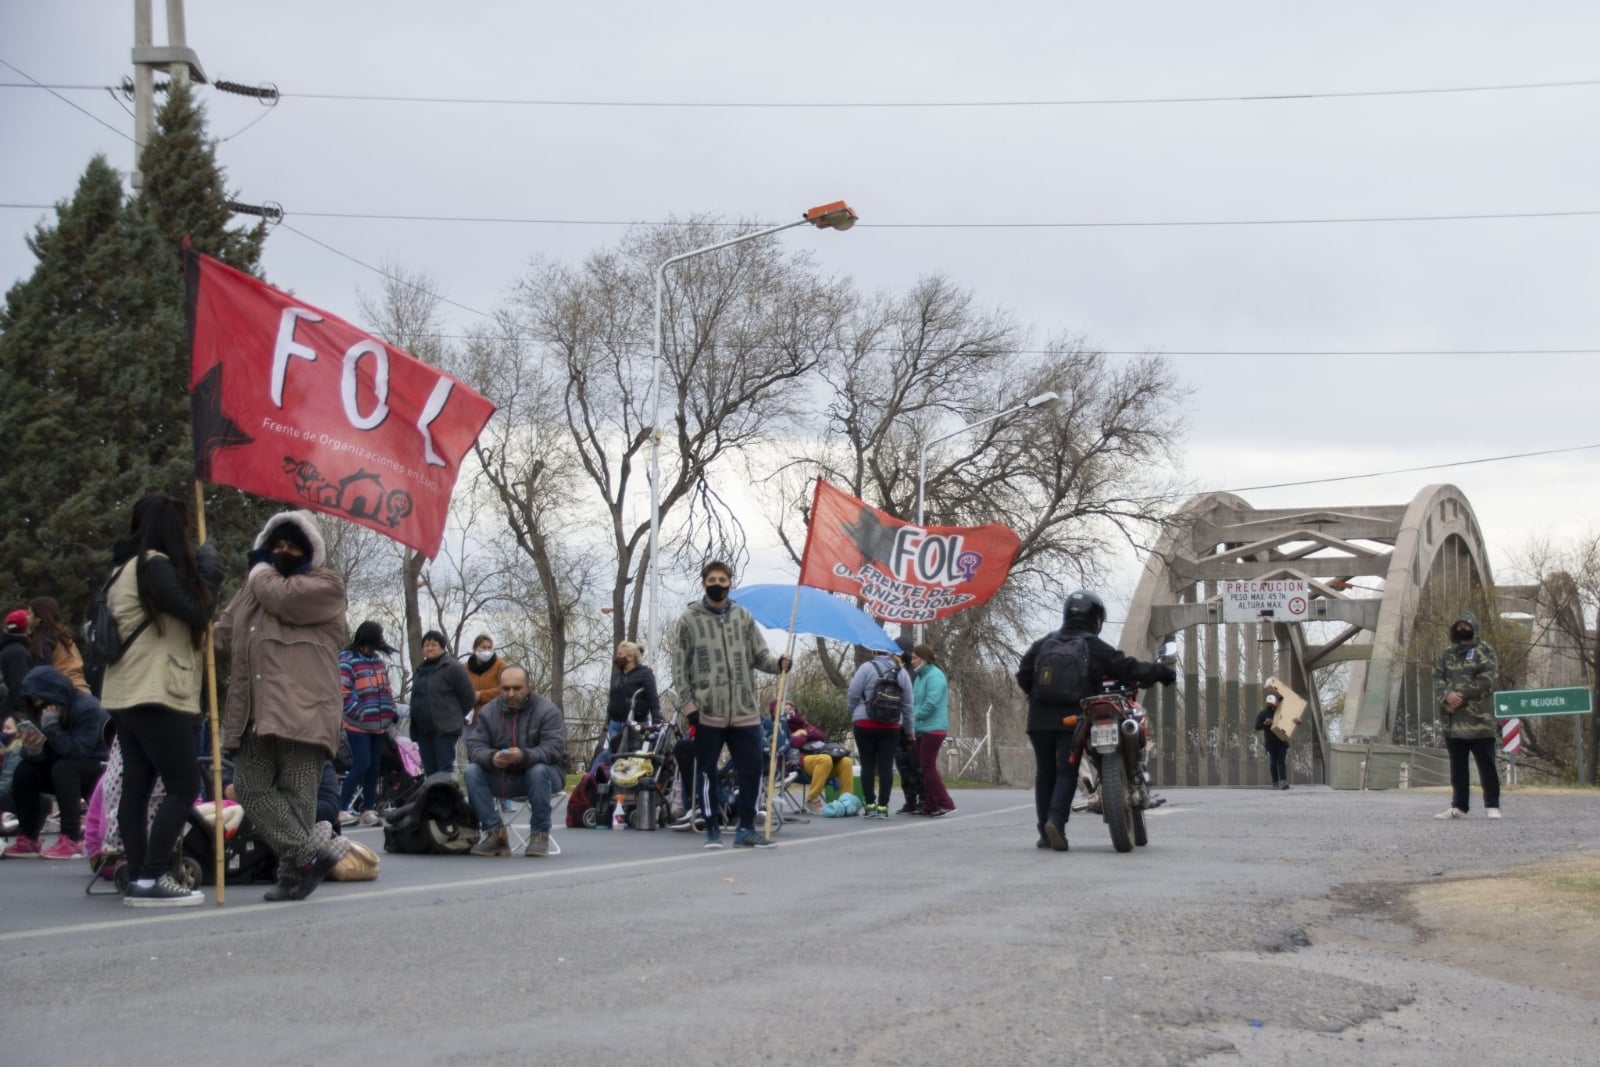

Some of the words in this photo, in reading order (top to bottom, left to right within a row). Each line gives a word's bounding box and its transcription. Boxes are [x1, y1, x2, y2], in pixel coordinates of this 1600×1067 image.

[270, 306, 455, 468] FOL
[262, 417, 301, 438] Frente
[303, 431, 317, 441] de
[319, 433, 405, 474] Organizaciones
[890, 525, 964, 585] FOL
[859, 564, 925, 598] FRENTE
[926, 587, 955, 599] DE
[1227, 582, 1304, 593] PRECAUCION
[1230, 593, 1248, 601] PESO
[1238, 601, 1265, 609] ALTURA
[876, 602, 937, 620] LUCHA
[1530, 696, 1565, 707] NEUQUÉN
